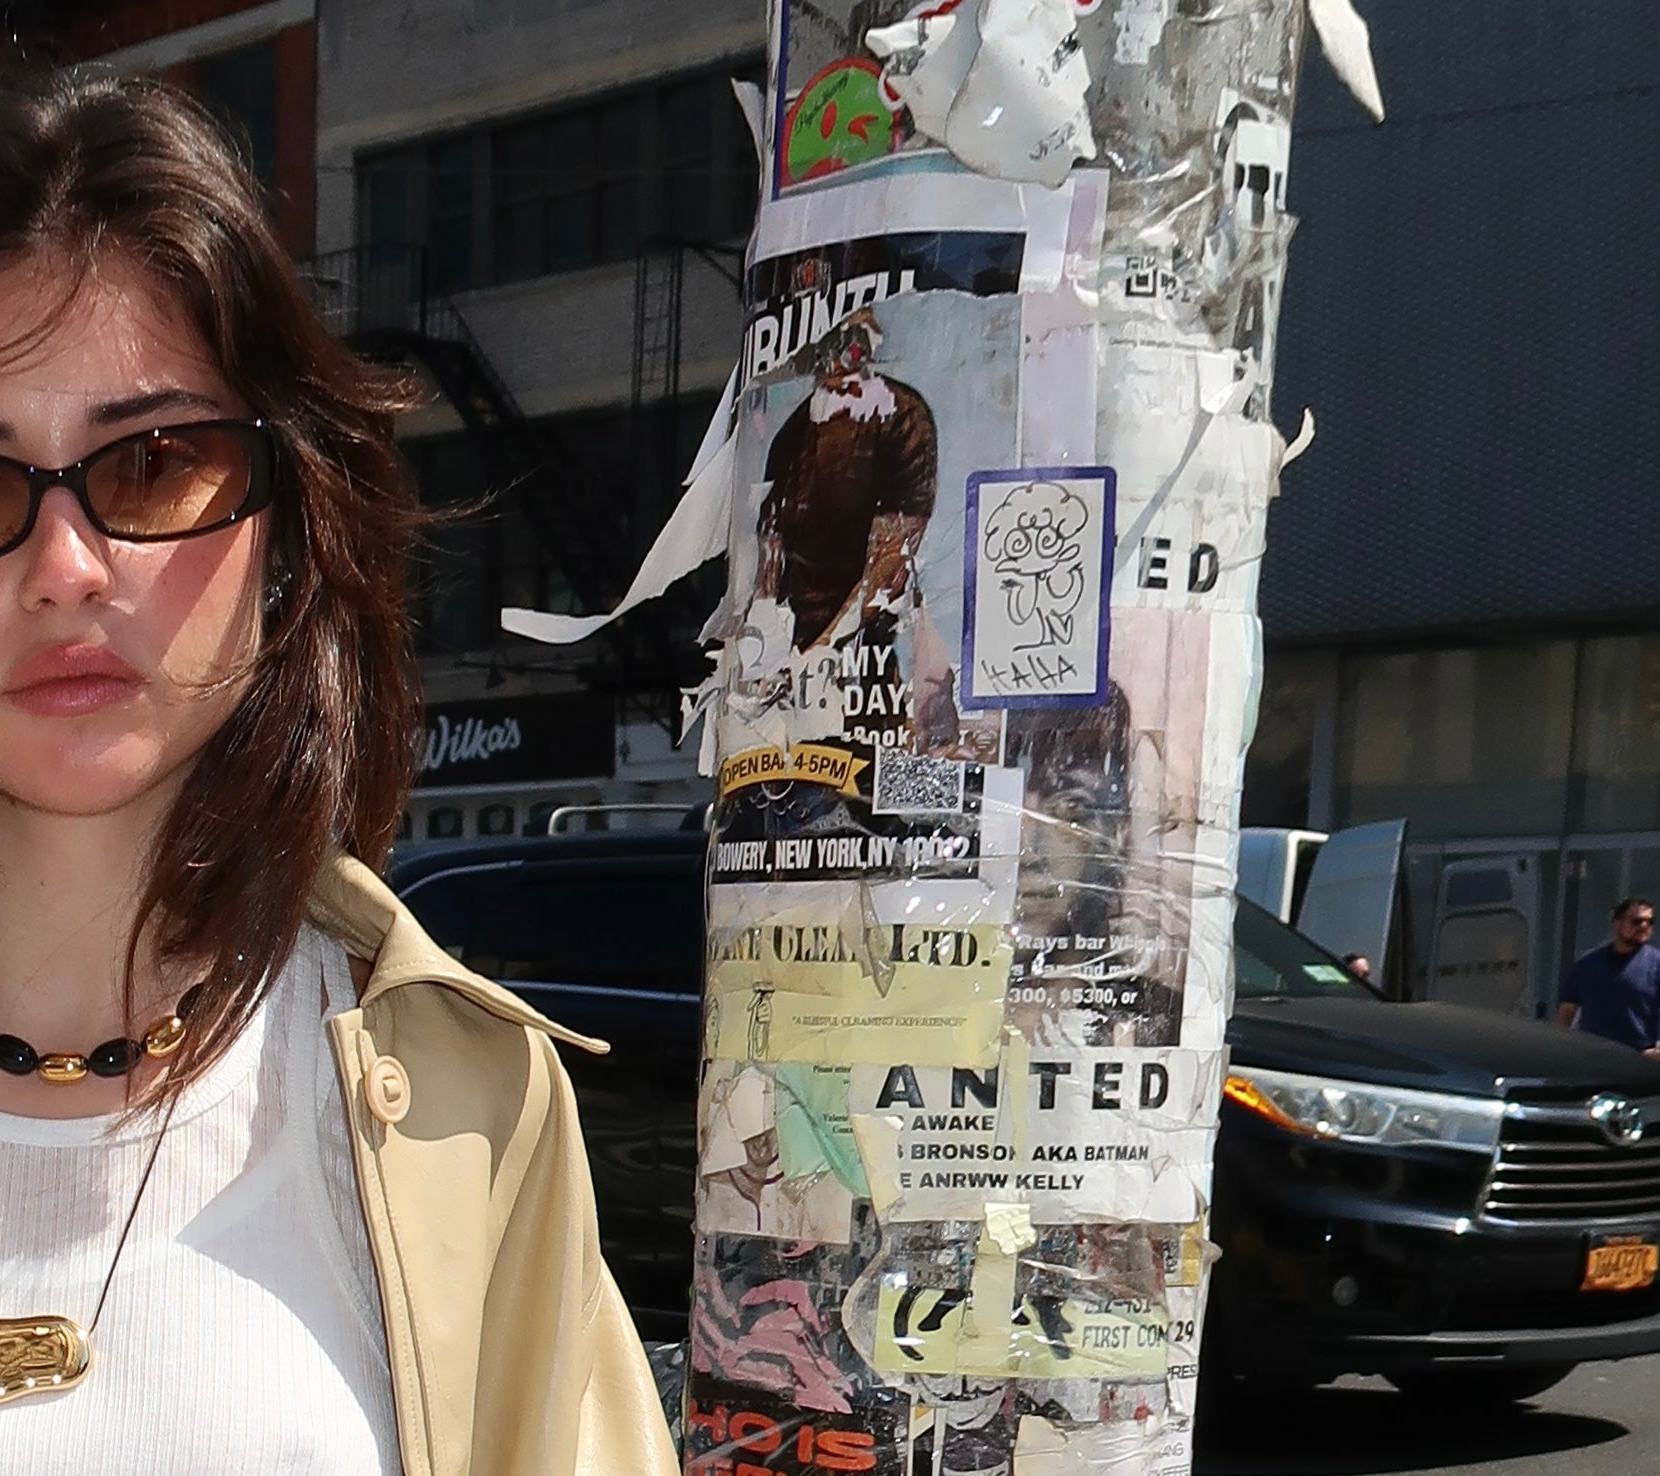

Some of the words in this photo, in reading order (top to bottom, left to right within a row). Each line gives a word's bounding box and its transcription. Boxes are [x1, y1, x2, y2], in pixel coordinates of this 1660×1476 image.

[842, 645, 892, 678] MY
[981, 655, 1077, 694] HAHA
[724, 755, 758, 786] OPEN
[761, 752, 785, 772] BA
[794, 752, 847, 781] 4-5PM
[775, 840, 813, 868] NEW
[1121, 991, 1138, 1004] or
[911, 1115, 995, 1131] AWAKE
[1032, 1146, 1077, 1161] AKA
[1084, 1146, 1149, 1161] BATMAN
[1015, 1174, 1084, 1190] KELLY
[1082, 1325, 1131, 1348] FIRST
[797, 1425, 878, 1471] IS
